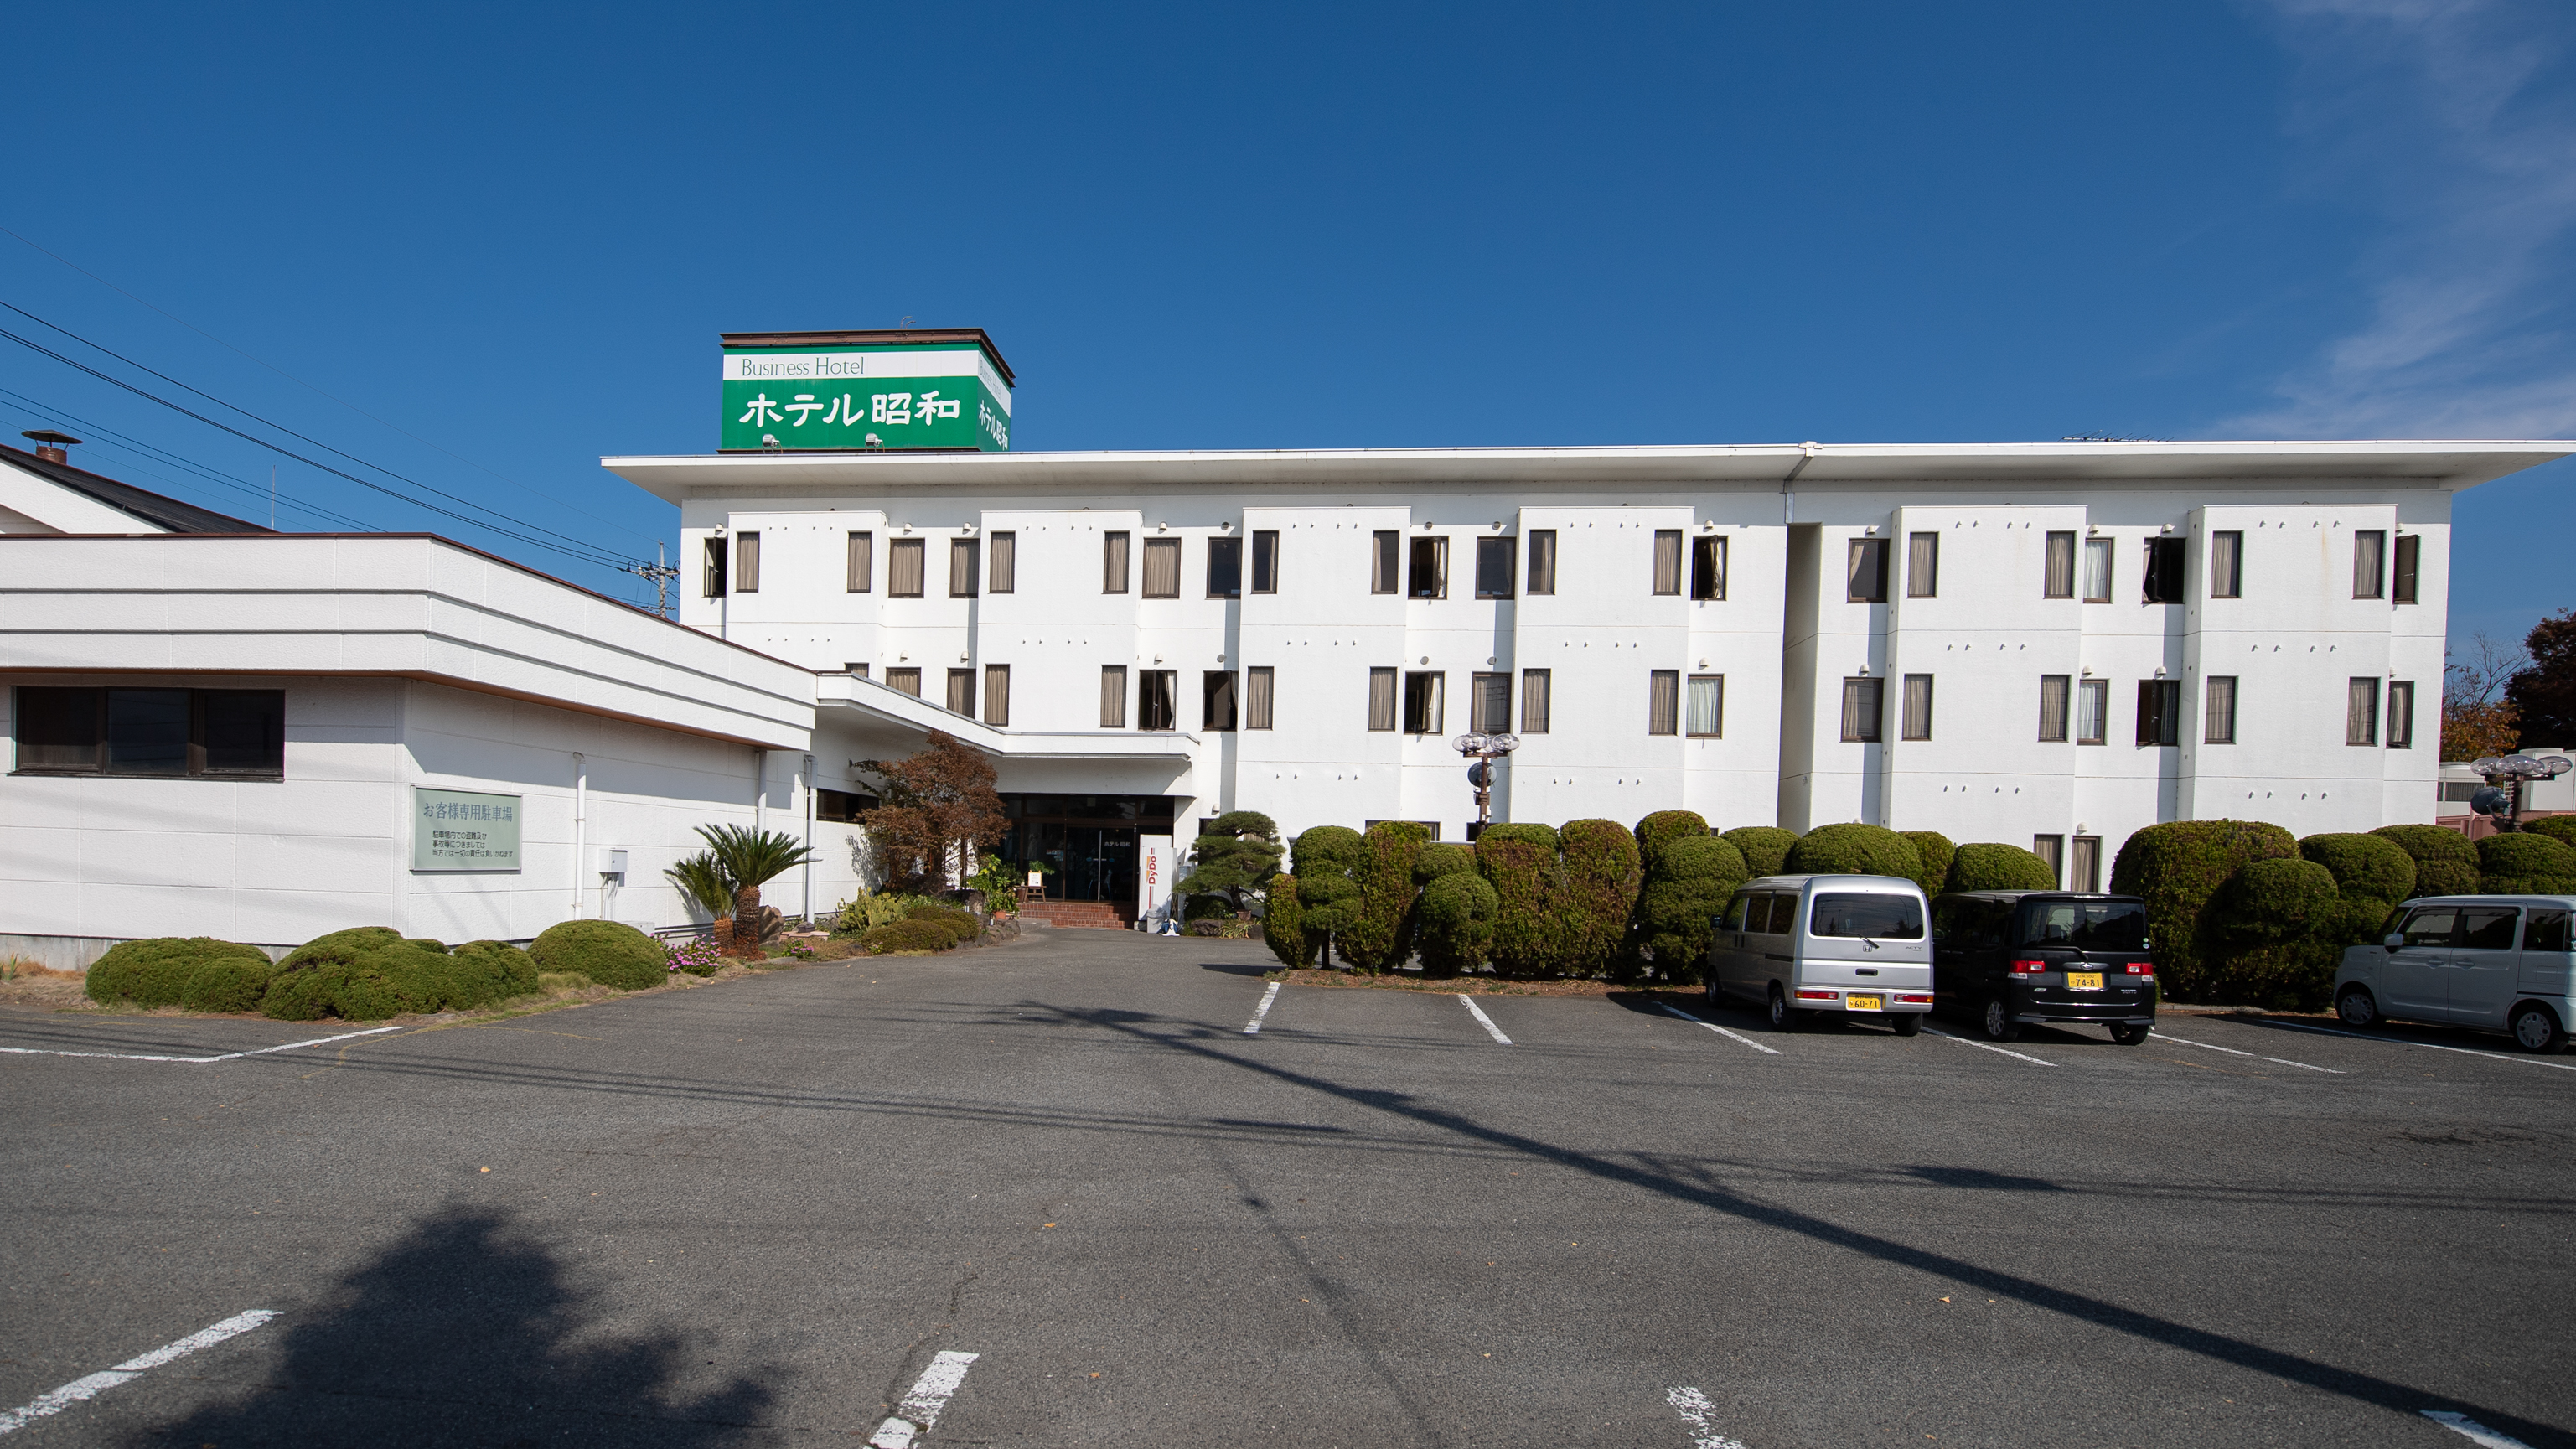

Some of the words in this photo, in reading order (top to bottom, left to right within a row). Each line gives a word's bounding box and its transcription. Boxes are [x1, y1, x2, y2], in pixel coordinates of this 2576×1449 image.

[742, 358, 810, 376] Business
[815, 356, 864, 375] Hotel
[738, 390, 960, 428] ホテル昭和
[979, 399, 1008, 451] ホテル昭和
[423, 801, 513, 823] お客様専用駐車場
[1149, 856, 1158, 885] DyDo
[2076, 979, 2100, 987] 74-81
[1854, 1000, 1877, 1008] 60-71
